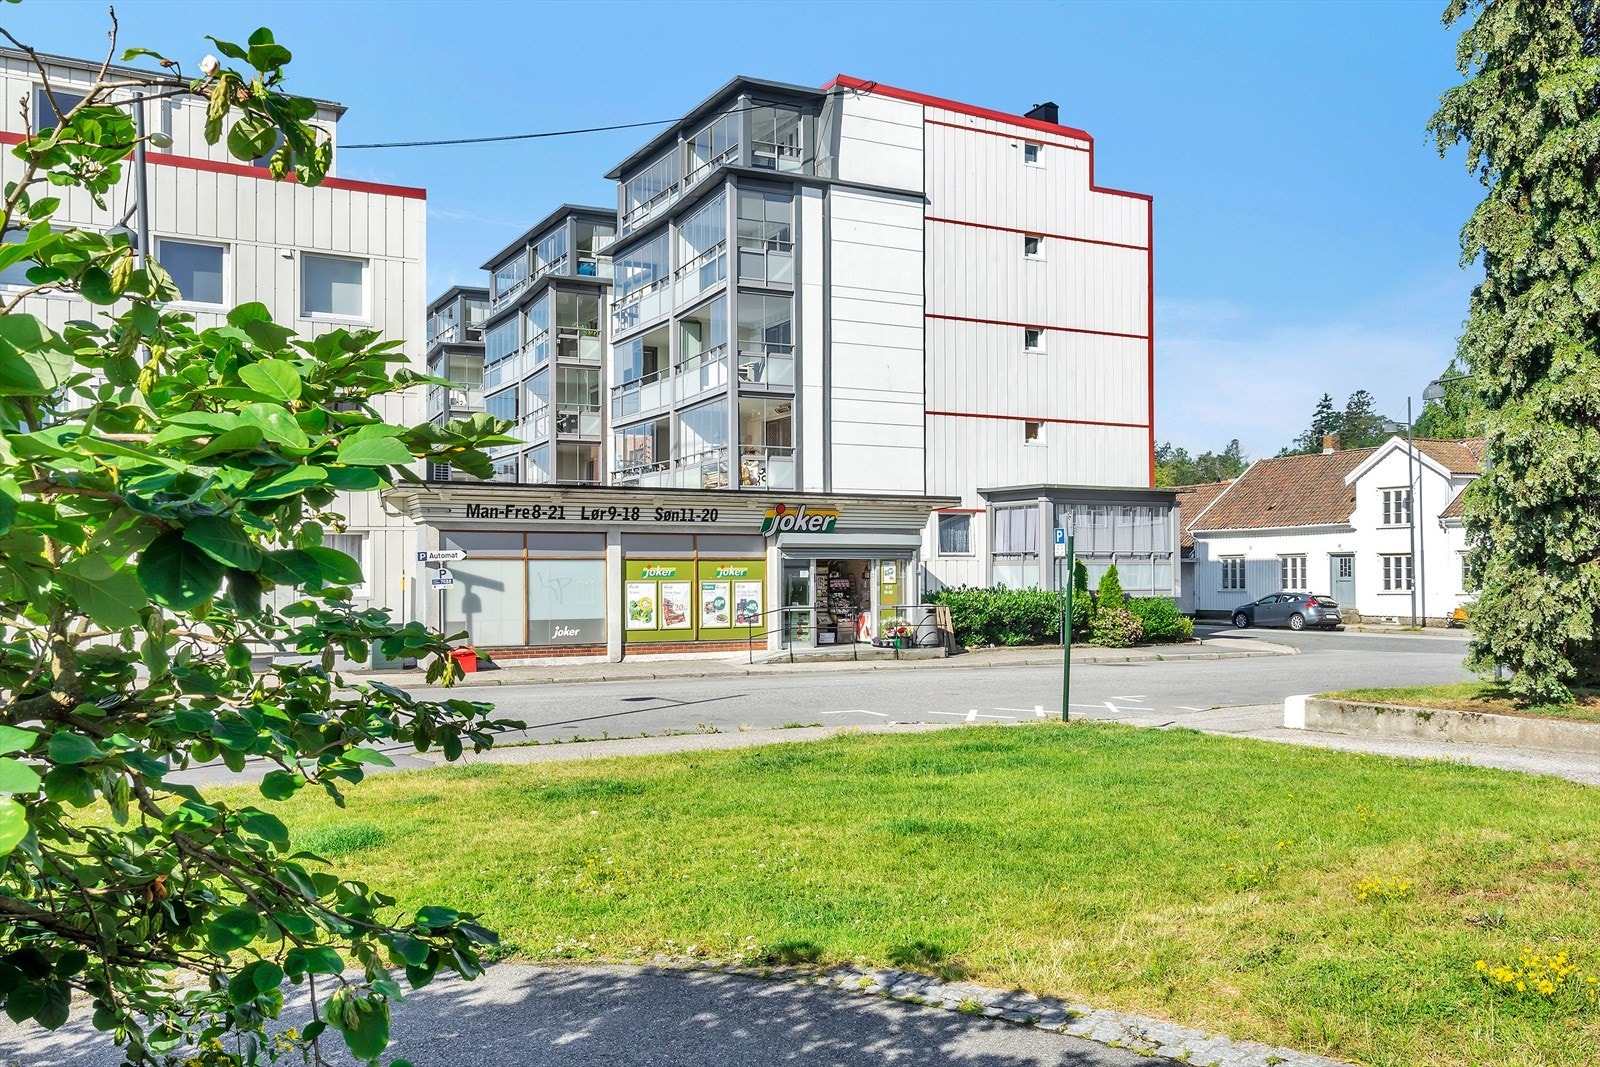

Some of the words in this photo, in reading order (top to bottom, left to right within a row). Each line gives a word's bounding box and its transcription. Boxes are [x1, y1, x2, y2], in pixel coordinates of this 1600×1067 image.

[763, 503, 836, 537] joker
[1056, 530, 1062, 542] P
[420, 552, 426, 560] P
[439, 569, 447, 579] P
[643, 564, 675, 579] joker
[717, 564, 746, 579] joker
[551, 625, 580, 639] joker
